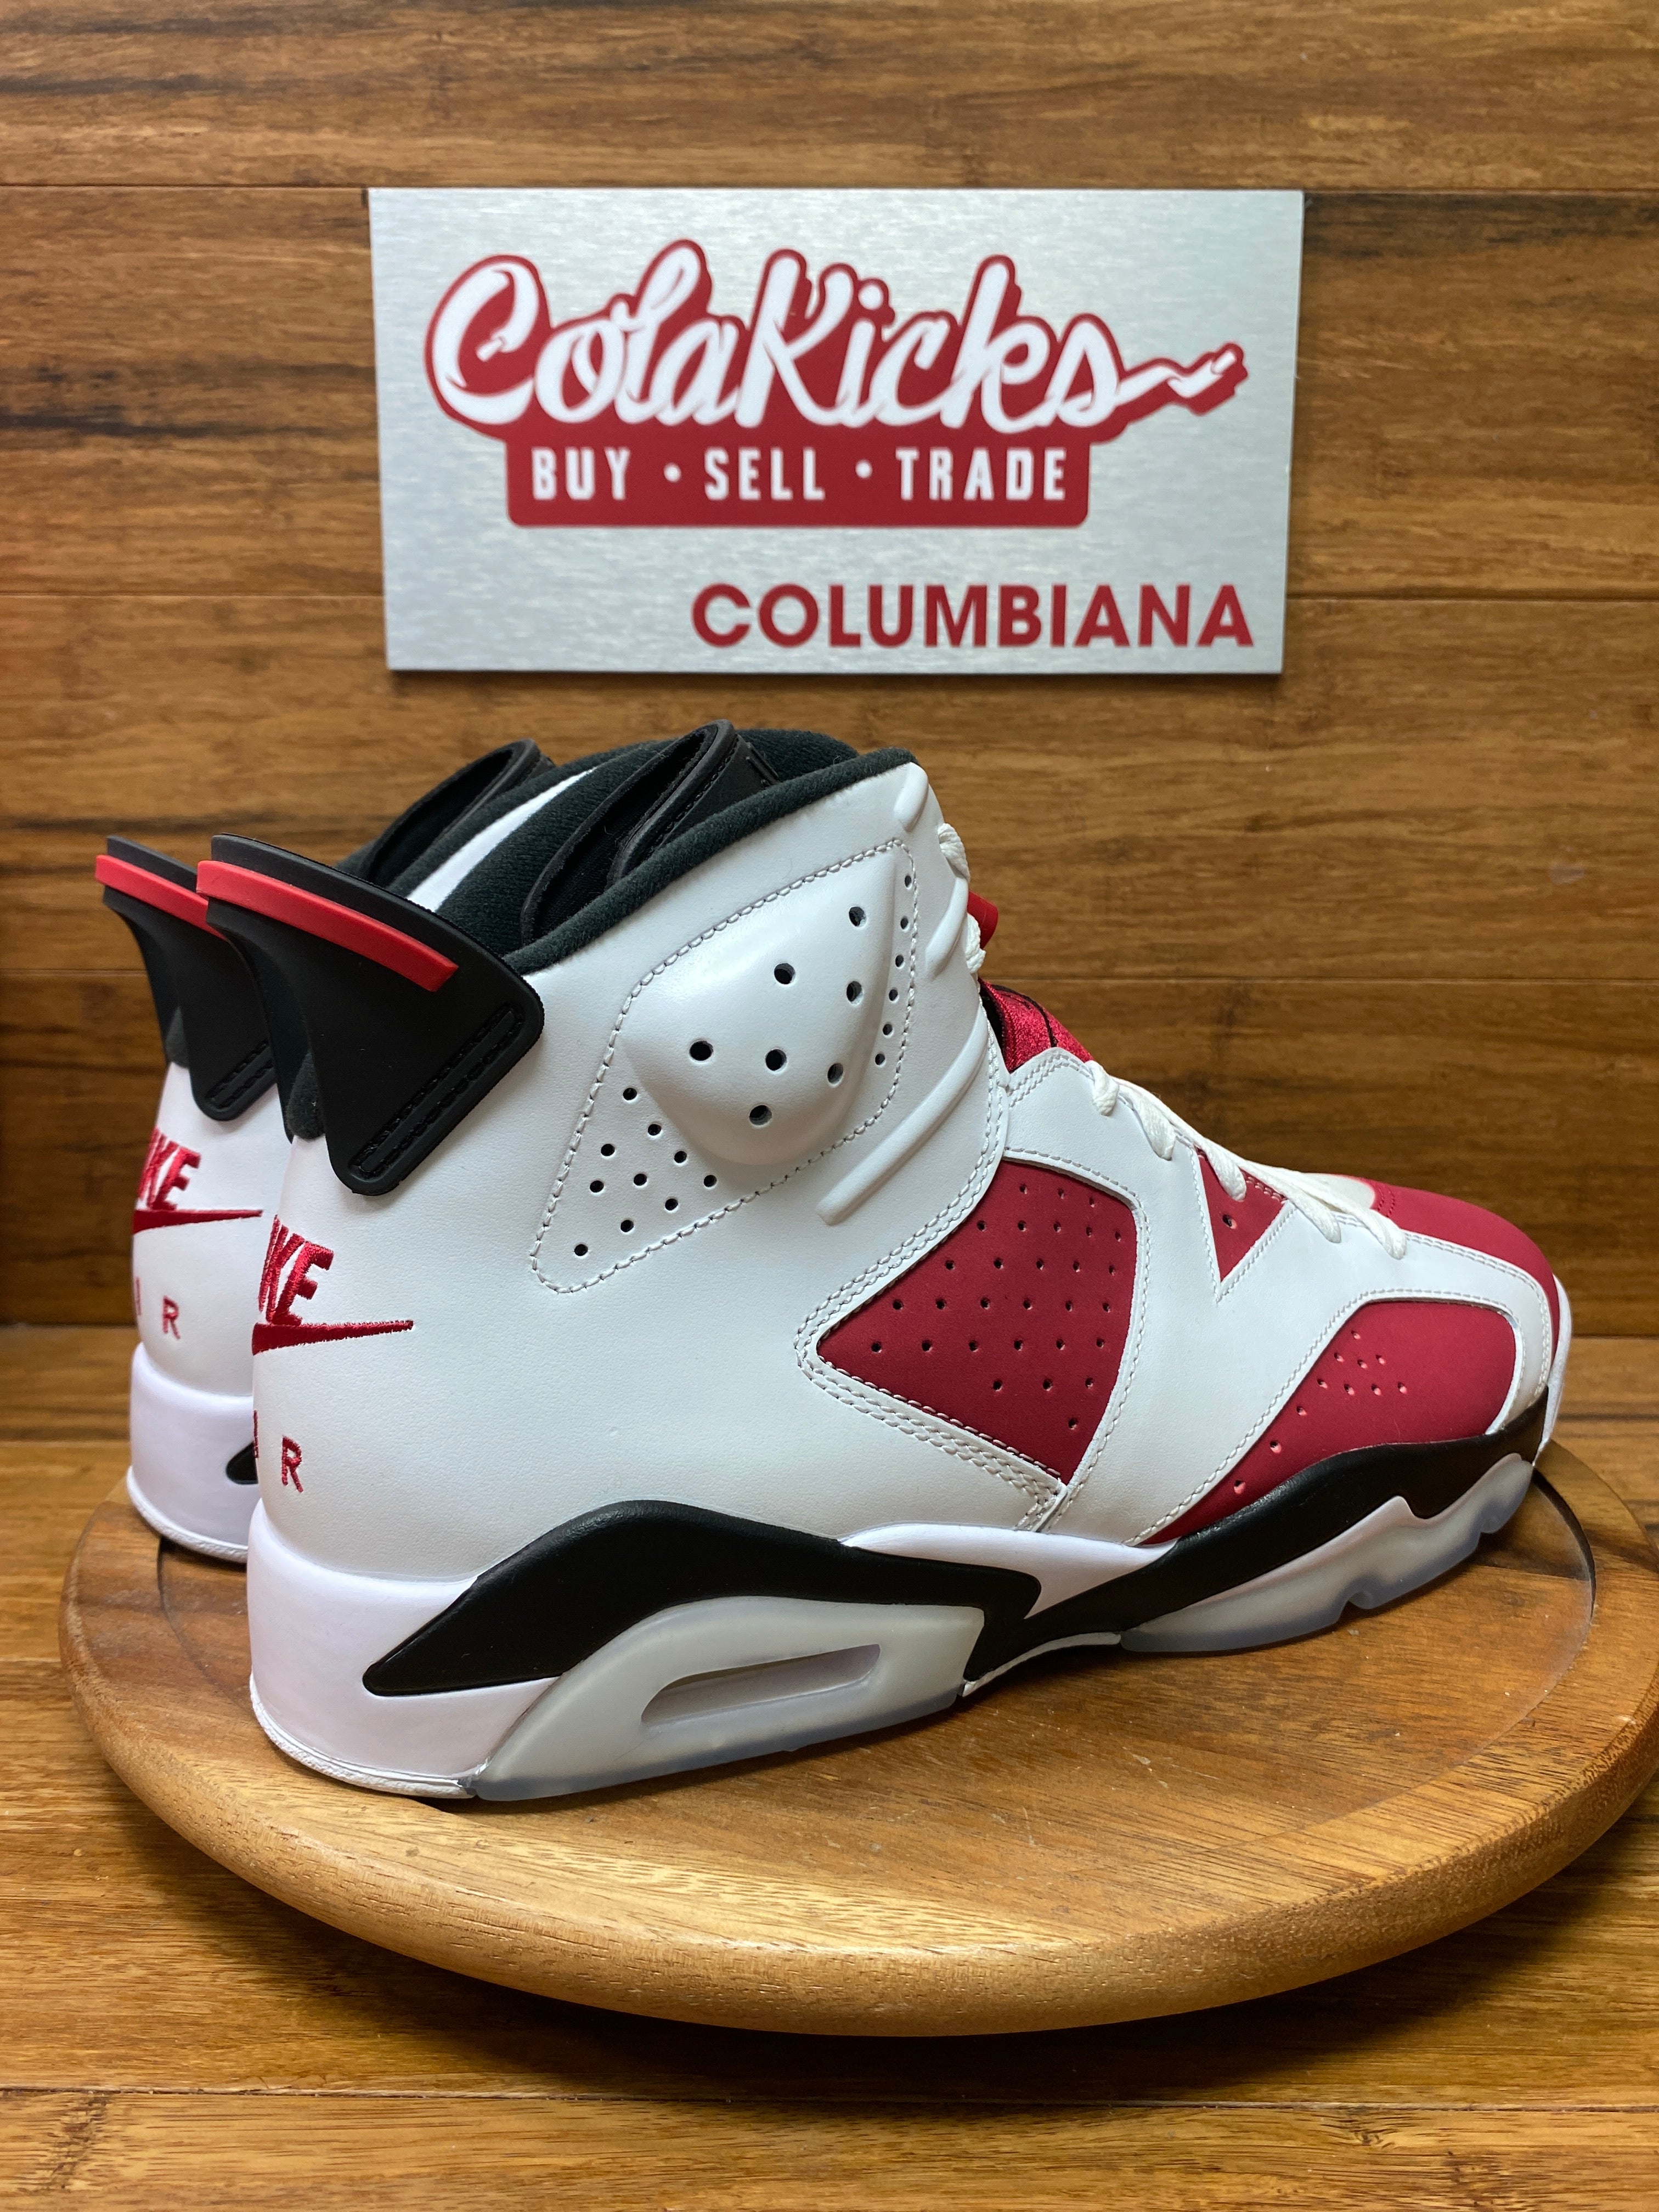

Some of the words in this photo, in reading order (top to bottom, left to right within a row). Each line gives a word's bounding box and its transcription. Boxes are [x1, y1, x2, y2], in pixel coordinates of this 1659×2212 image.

[430, 244, 1239, 436] ColaKicks
[531, 447, 630, 501] BUY
[704, 447, 826, 501] SELL
[894, 447, 1067, 501] TRADE
[691, 583, 1254, 648] COLUMBIANA
